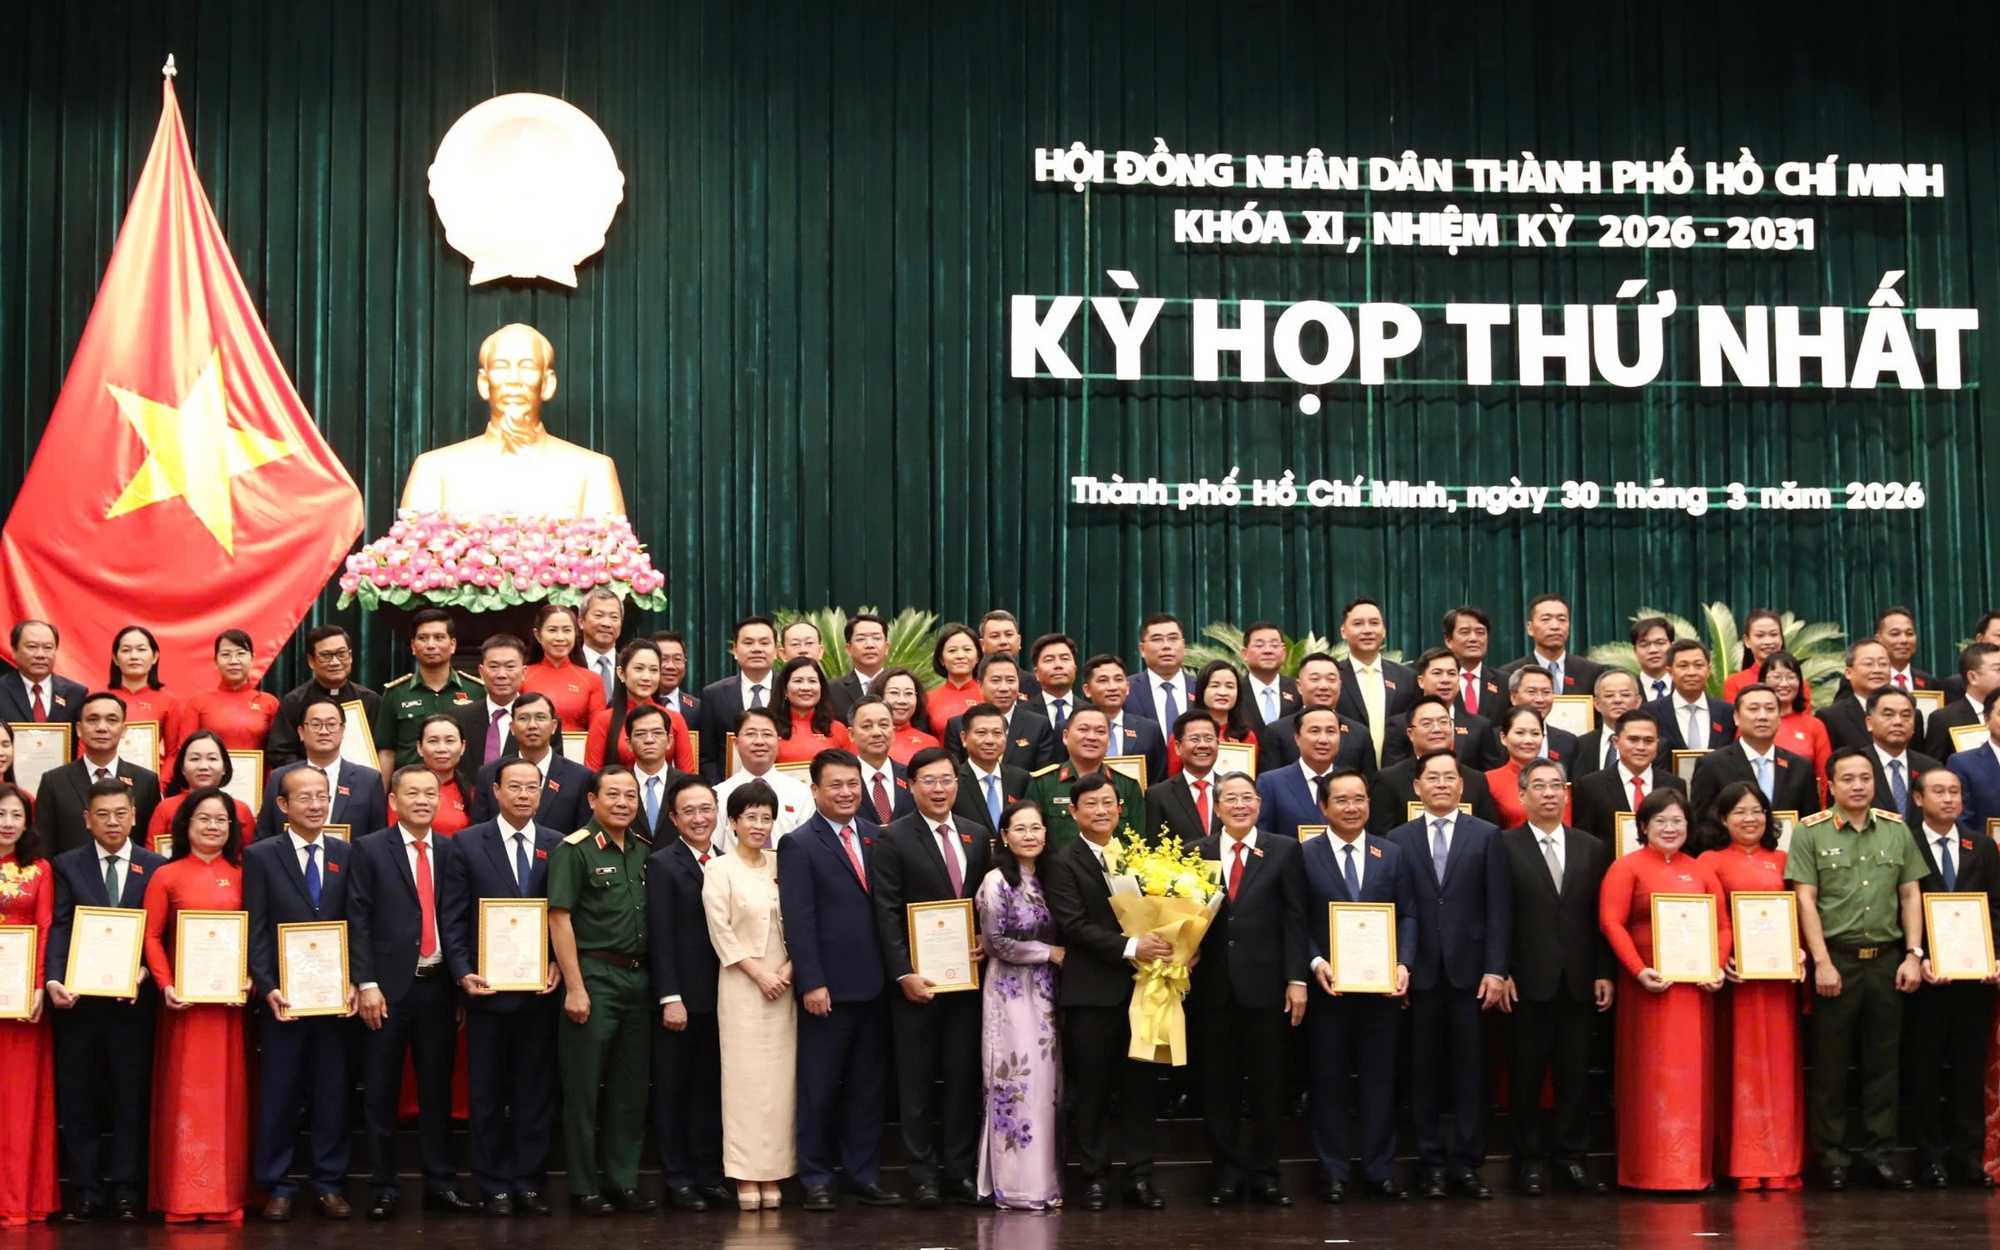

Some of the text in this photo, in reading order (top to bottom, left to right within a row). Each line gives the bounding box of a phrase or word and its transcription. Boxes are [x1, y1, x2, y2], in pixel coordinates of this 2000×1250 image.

[1035, 137, 1944, 197] HỘI ĐỒNG NHÂN DÂN THÀNH PHỐ HỒ CHÍ MINH
[1174, 201, 1291, 243] KHÓA
[1302, 211, 1361, 254] XI,
[1373, 204, 1499, 256] NHIỆM
[1518, 203, 1575, 247] KỲ
[1599, 215, 1697, 248] 2026
[1726, 216, 1814, 250] 2031
[1011, 269, 1979, 415] KỲ HỌP THỨ NHẤT
[1071, 473, 1168, 505] Thành
[1178, 466, 1241, 510] phố
[1253, 469, 1298, 506] Hồ
[1307, 475, 1364, 507] Chí
[1467, 476, 1549, 515] ngày
[1561, 481, 1600, 509] 30
[1614, 478, 1708, 516] tháng
[1726, 482, 1747, 510] 3
[1760, 481, 1831, 510] năm
[1846, 481, 1925, 510] 2026
